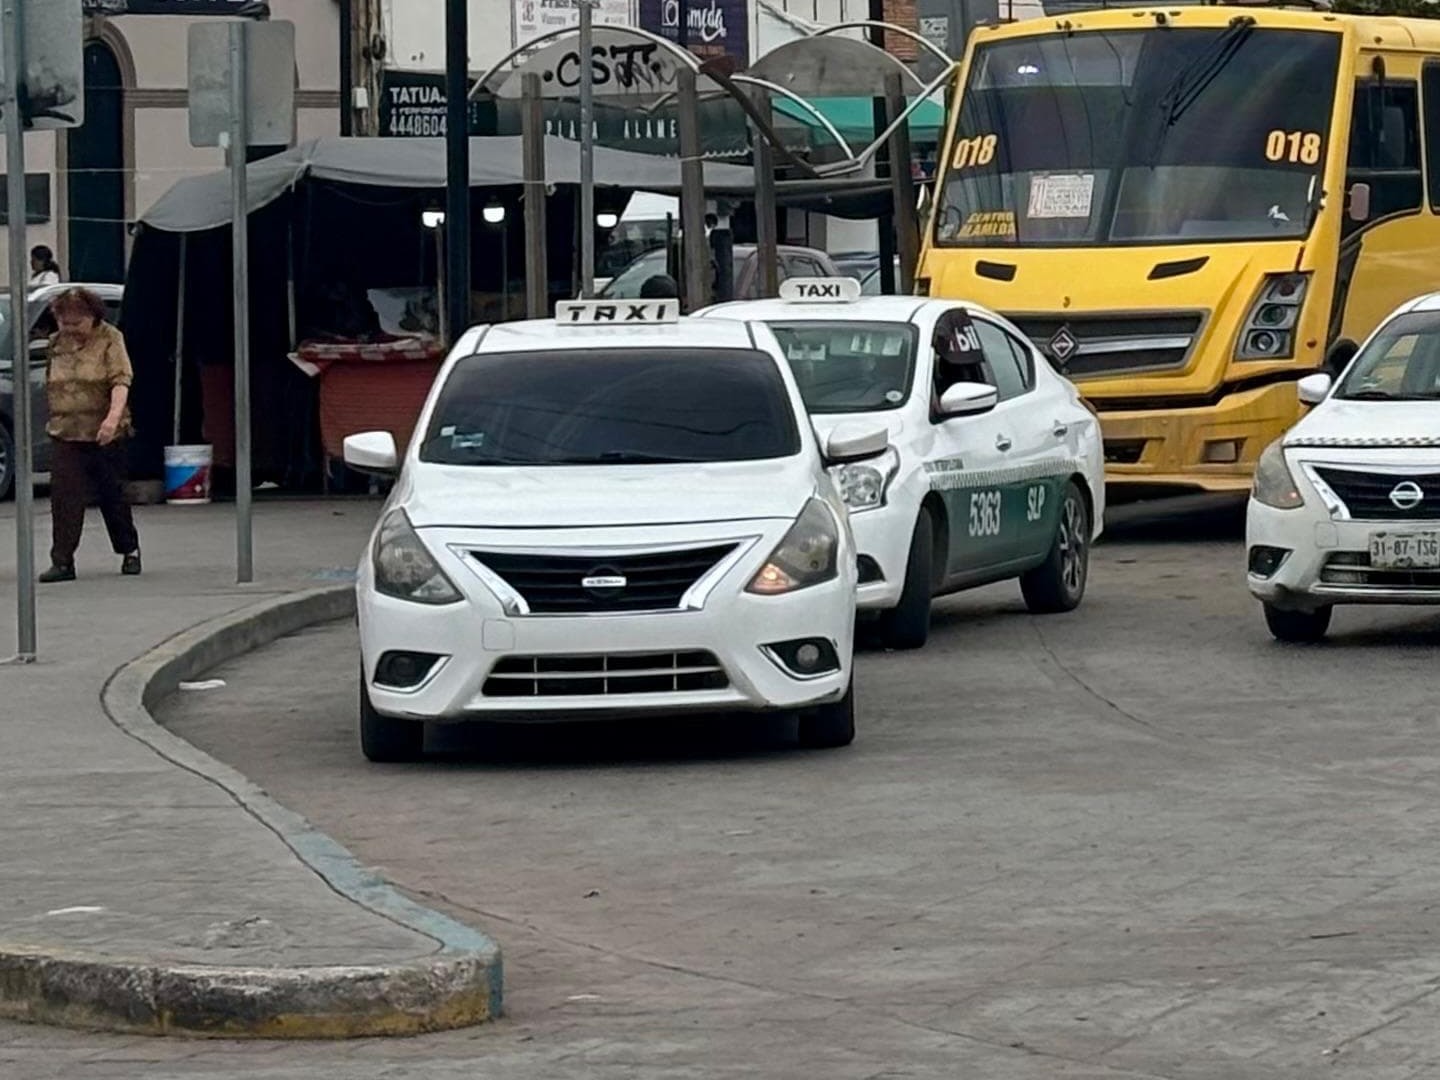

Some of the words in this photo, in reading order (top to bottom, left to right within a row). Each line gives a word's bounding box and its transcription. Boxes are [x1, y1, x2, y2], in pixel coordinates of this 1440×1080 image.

[546, 119, 599, 138] PLAA
[952, 134, 997, 169] 018
[1265, 130, 1321, 165] 018
[796, 284, 841, 297] TAXI
[567, 305, 666, 321] TAXI
[968, 491, 1002, 537] 5363
[1027, 485, 1046, 521] SLP
